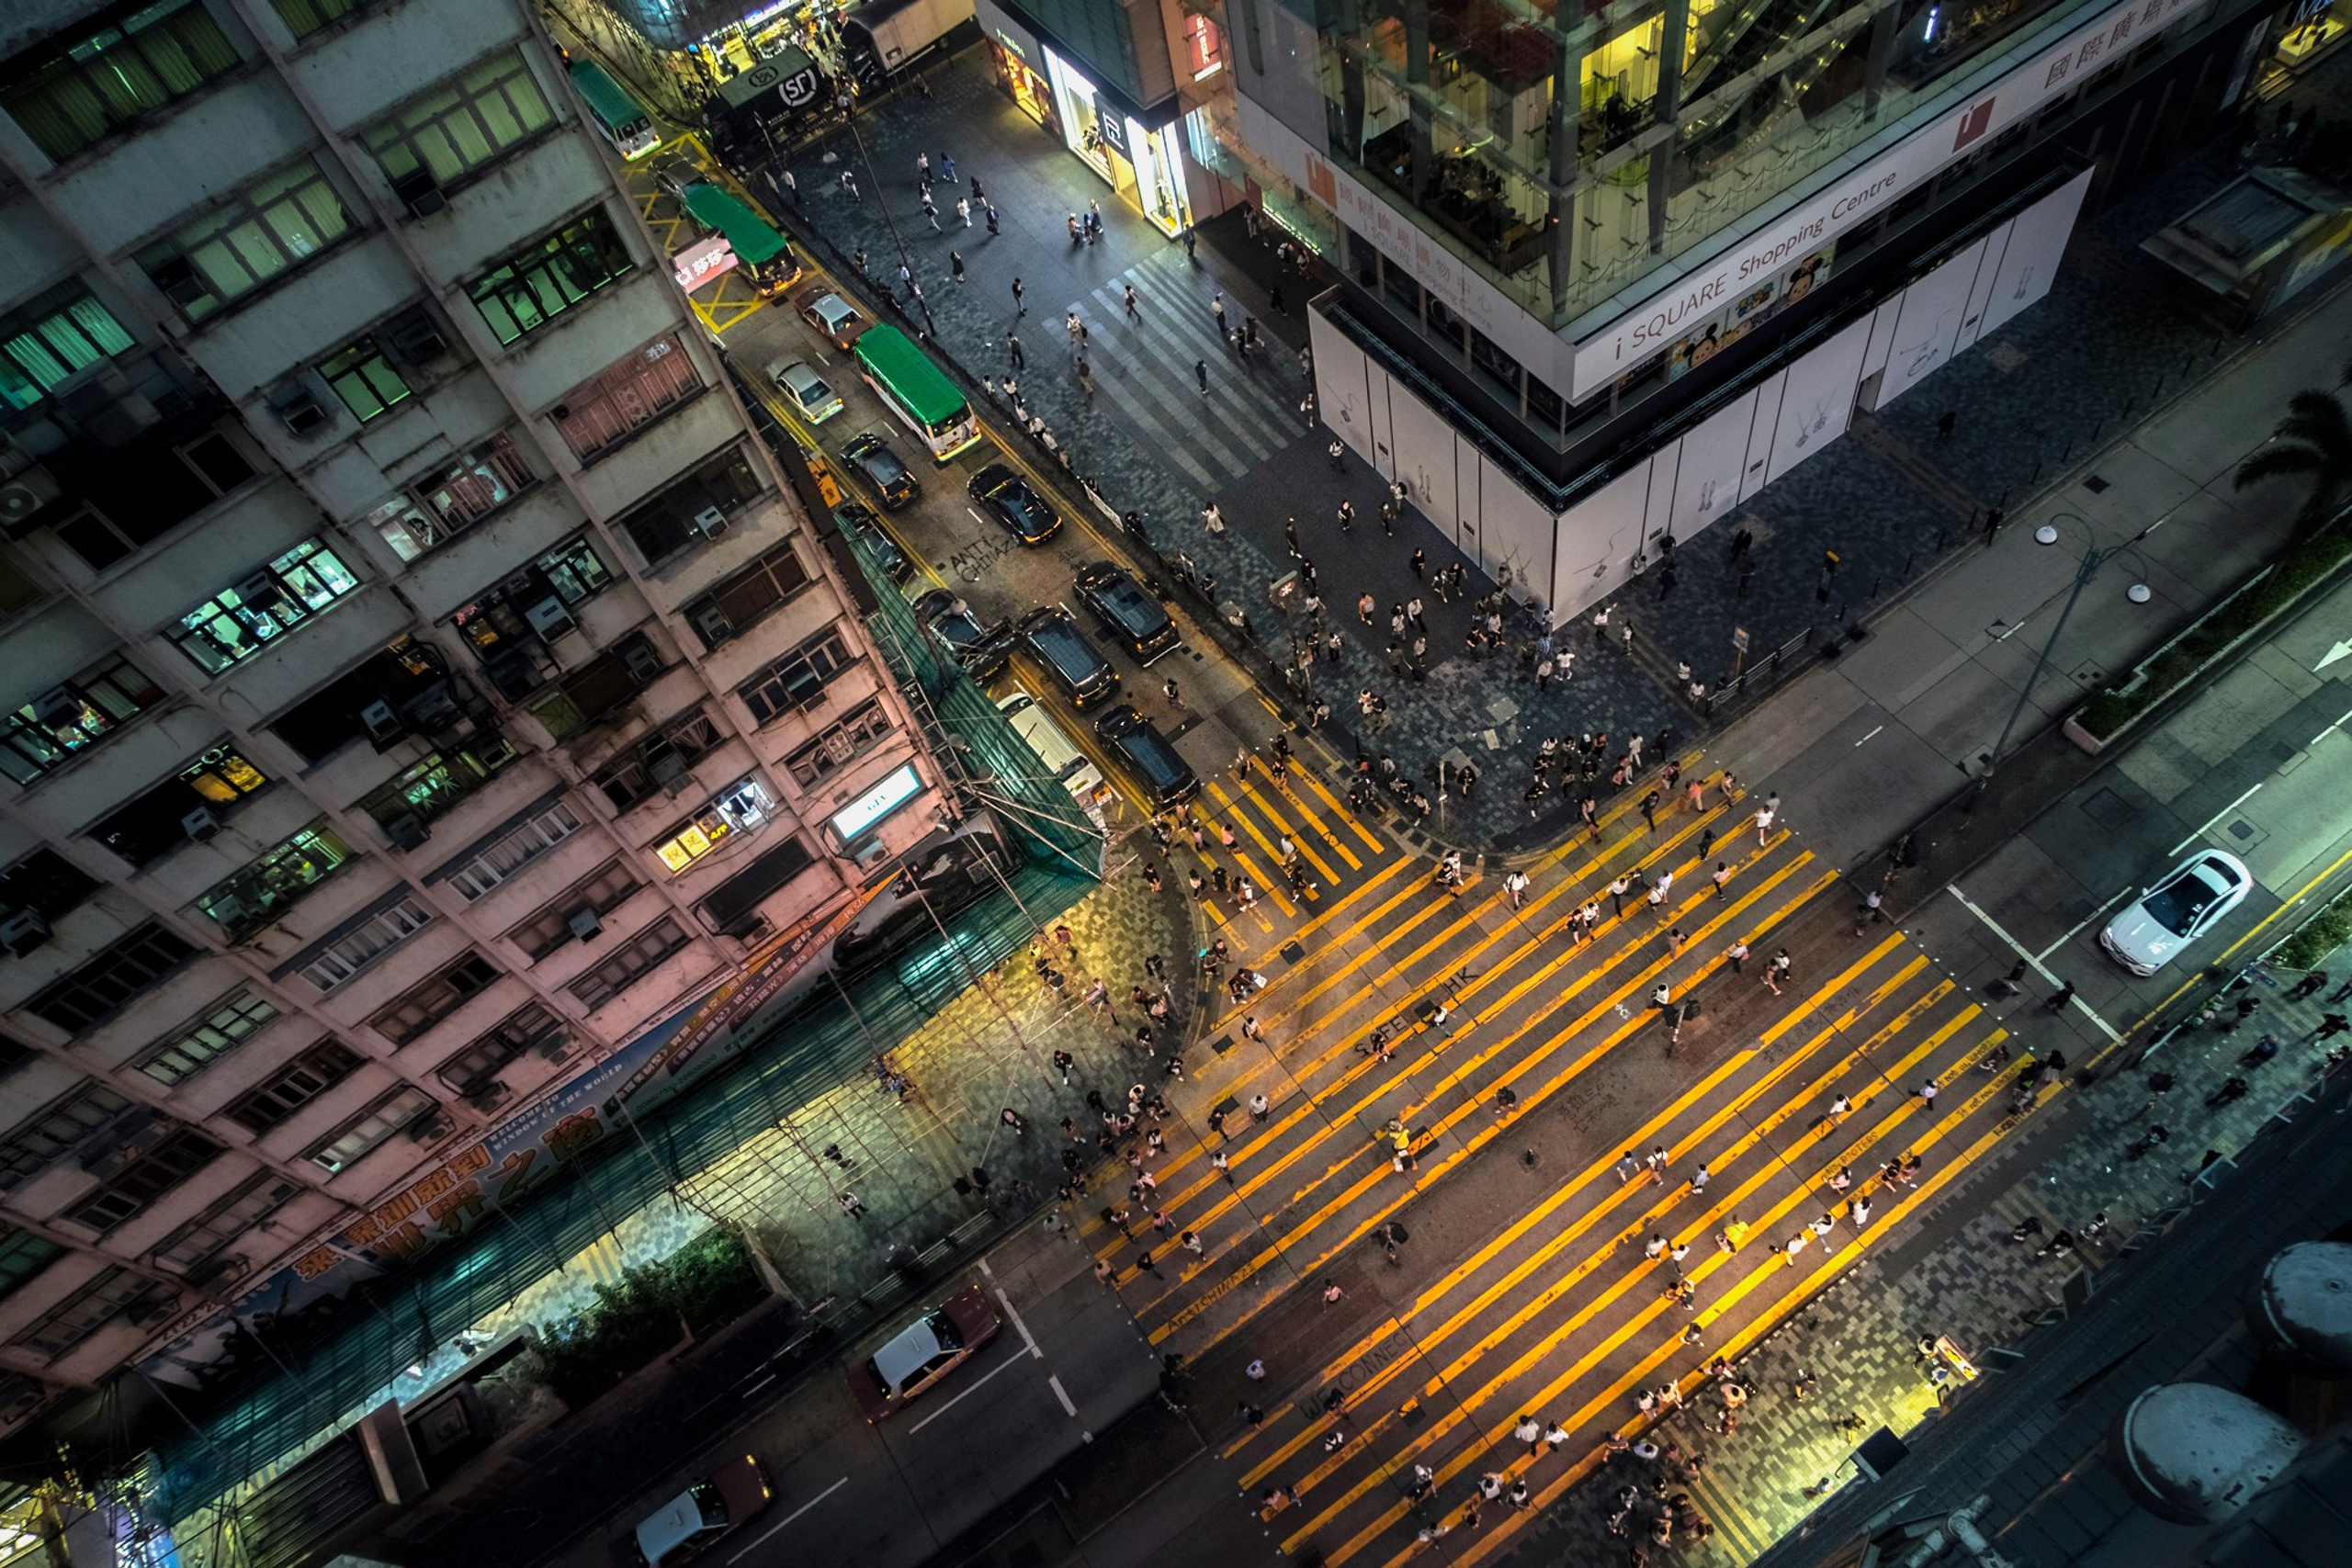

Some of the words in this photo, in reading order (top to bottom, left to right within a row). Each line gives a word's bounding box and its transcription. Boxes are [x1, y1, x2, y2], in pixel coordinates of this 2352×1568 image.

[1631, 278, 1726, 350] SQUARE
[1737, 214, 1826, 282] Shopping
[1832, 169, 1898, 221] Centre
[1443, 967, 1480, 995] HK
[487, 1103, 545, 1143] WELCOME
[544, 1091, 560, 1107] TO
[492, 1116, 544, 1152] WINDOW
[558, 1088, 584, 1108] THE
[1339, 1322, 1417, 1392] CONNECT
